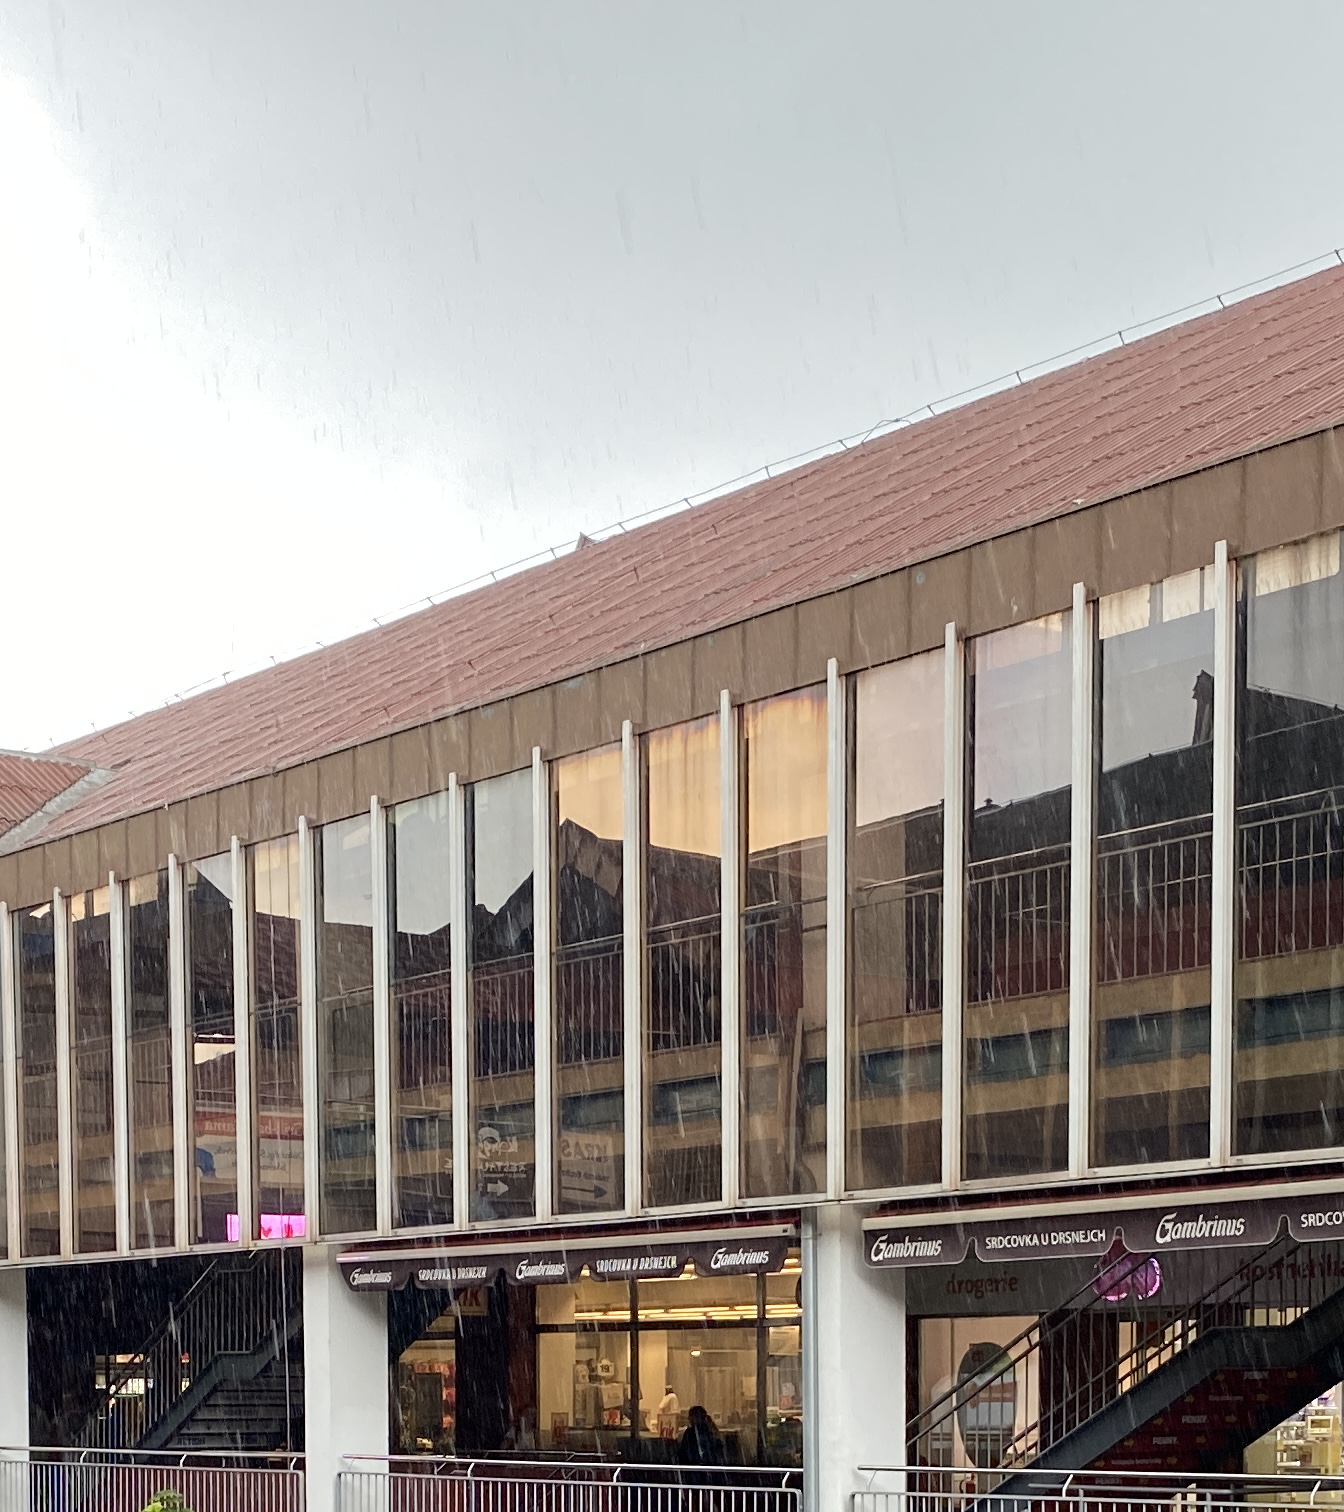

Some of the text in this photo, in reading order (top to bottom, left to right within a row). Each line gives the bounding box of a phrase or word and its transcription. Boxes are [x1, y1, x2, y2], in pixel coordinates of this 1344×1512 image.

[985, 1229, 1106, 1249] SRDCOVKA U DRSNEJCH
[1156, 1212, 1246, 1244] Gambrinus
[710, 1247, 770, 1269] Gambrinus
[871, 1234, 942, 1262] Gambrinus
[350, 1268, 392, 1286] Gambrinus
[516, 1258, 565, 1279] Gambrinus
[945, 1272, 1018, 1298] drogerie
